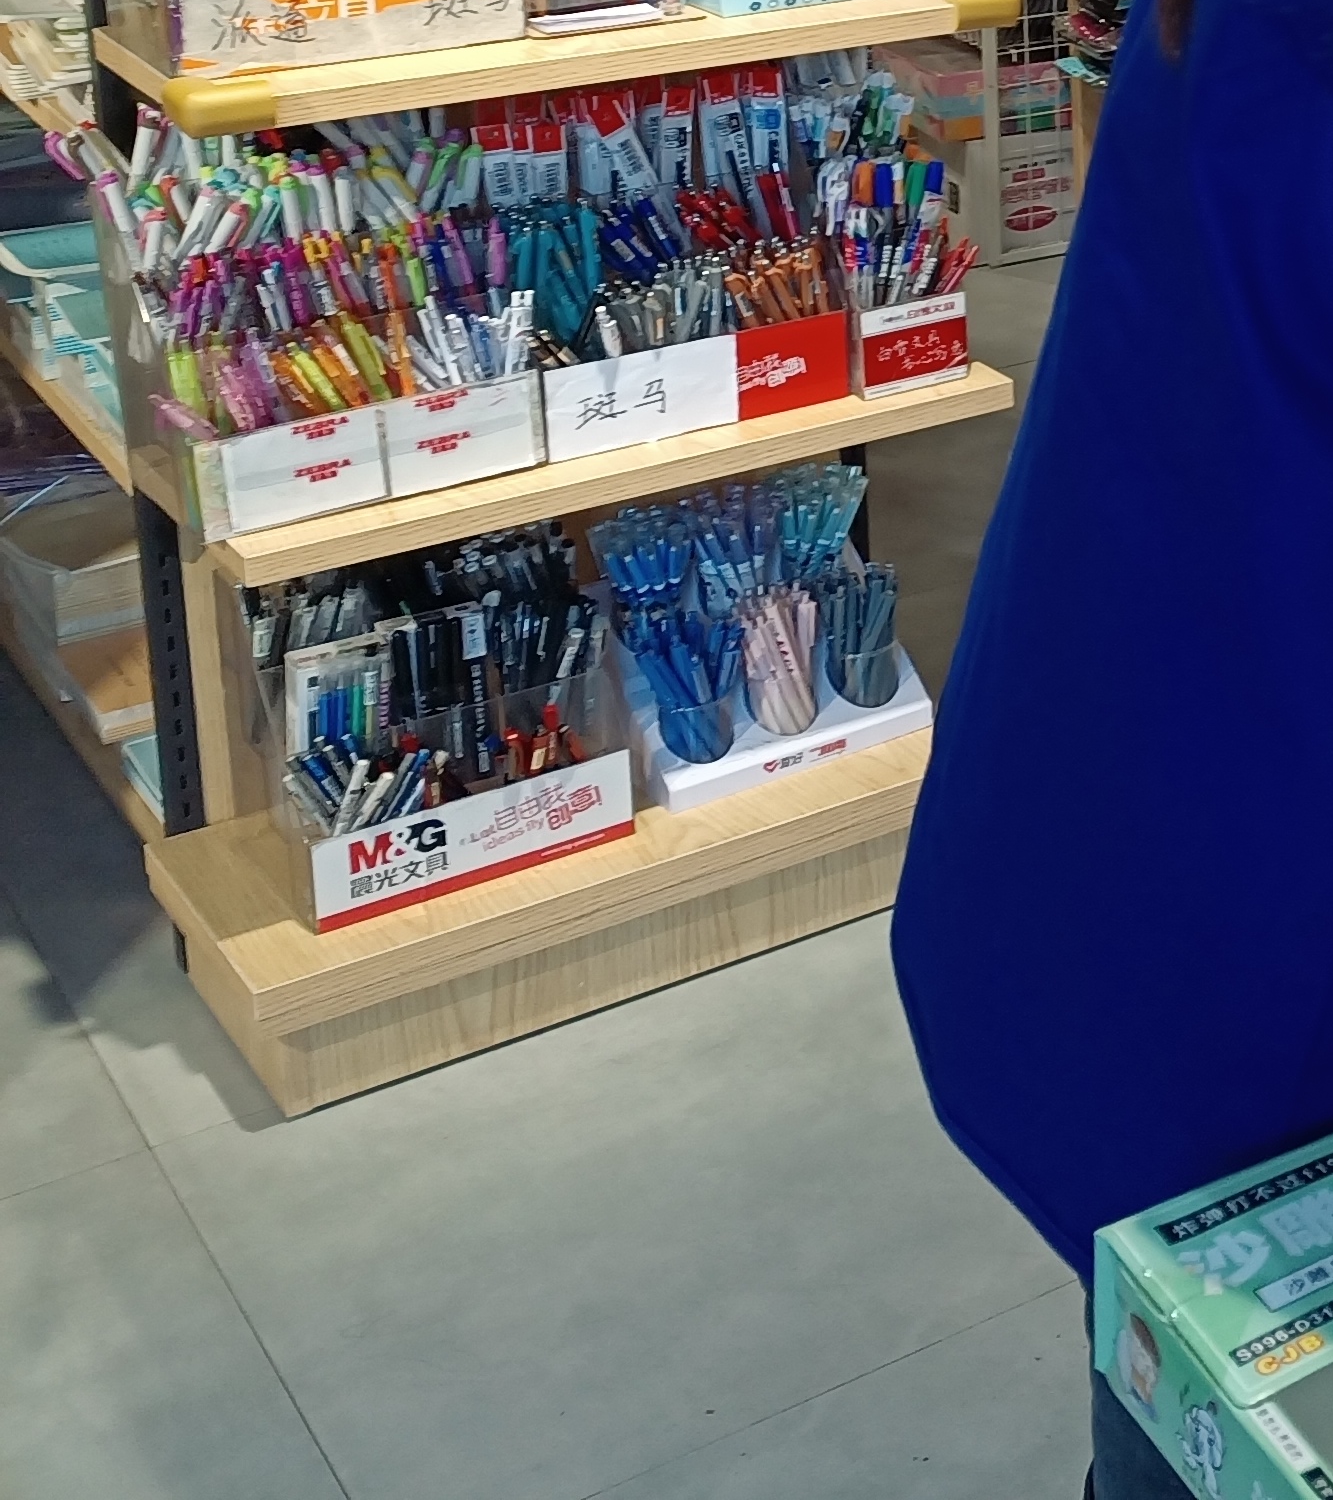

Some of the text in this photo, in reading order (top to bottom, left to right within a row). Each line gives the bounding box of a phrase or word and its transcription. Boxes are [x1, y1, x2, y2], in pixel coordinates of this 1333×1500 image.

[574, 378, 667, 431] 斑马
[291, 415, 350, 435] ZEBRA
[416, 430, 471, 450] ZEBRA
[293, 457, 352, 478] ZEBRA
[349, 818, 447, 875] M&G
[482, 827, 526, 852] ideas
